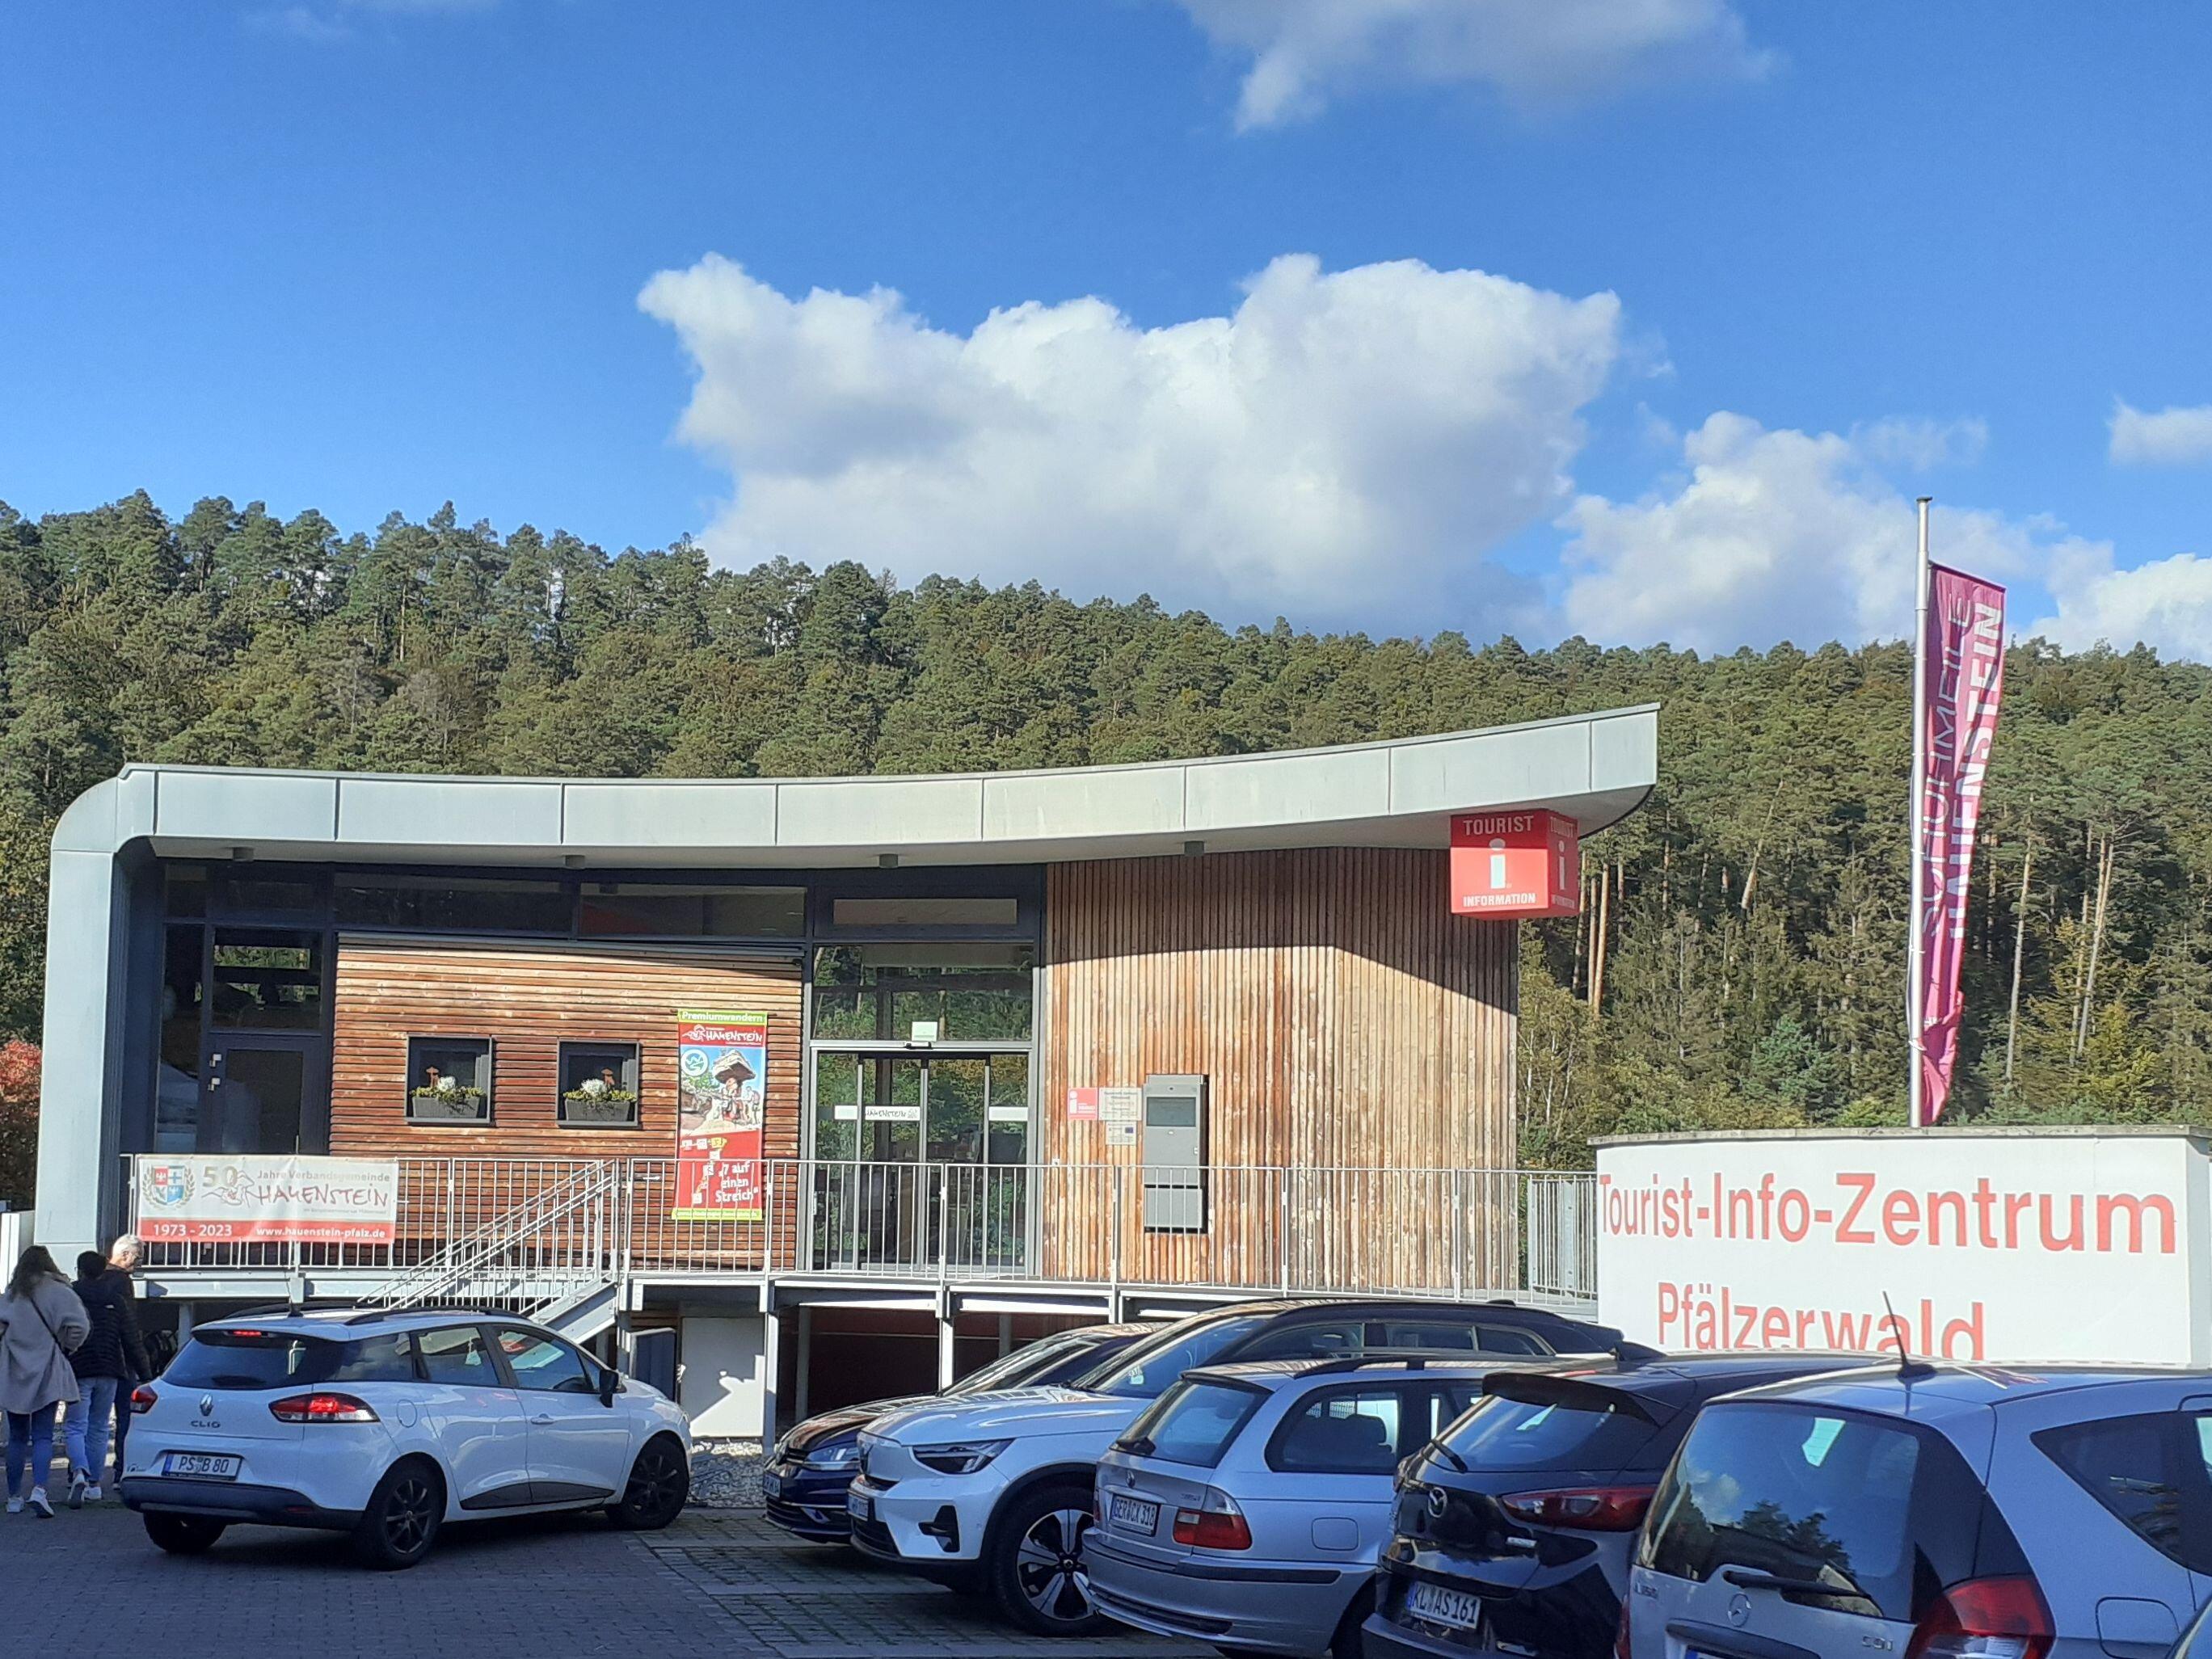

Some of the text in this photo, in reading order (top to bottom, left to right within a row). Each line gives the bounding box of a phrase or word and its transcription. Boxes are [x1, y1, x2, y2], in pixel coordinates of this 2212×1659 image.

[1464, 815, 1534, 836] TOURIST
[1464, 893, 1536, 907] INFORMATION
[682, 1011, 763, 1022] Premiumwandern
[732, 1160, 750, 1173] auf
[203, 1166, 238, 1187] 50
[258, 1170, 390, 1183] Jahre Verbandsgemeinde
[721, 1177, 748, 1189] einen
[1599, 1173, 2176, 1253] Tourist-Info-Zentrum
[154, 1224, 186, 1236] 1973
[199, 1224, 232, 1236] 2023
[256, 1227, 386, 1239] www.hauenstein-pfalz.de
[1658, 1282, 1983, 1360] Pfälzerwald
[179, 1456, 230, 1473] PS B 80
[1412, 1583, 1427, 1611] KL
[1433, 1589, 1451, 1616] AS
[1451, 1595, 1478, 1623] 161
